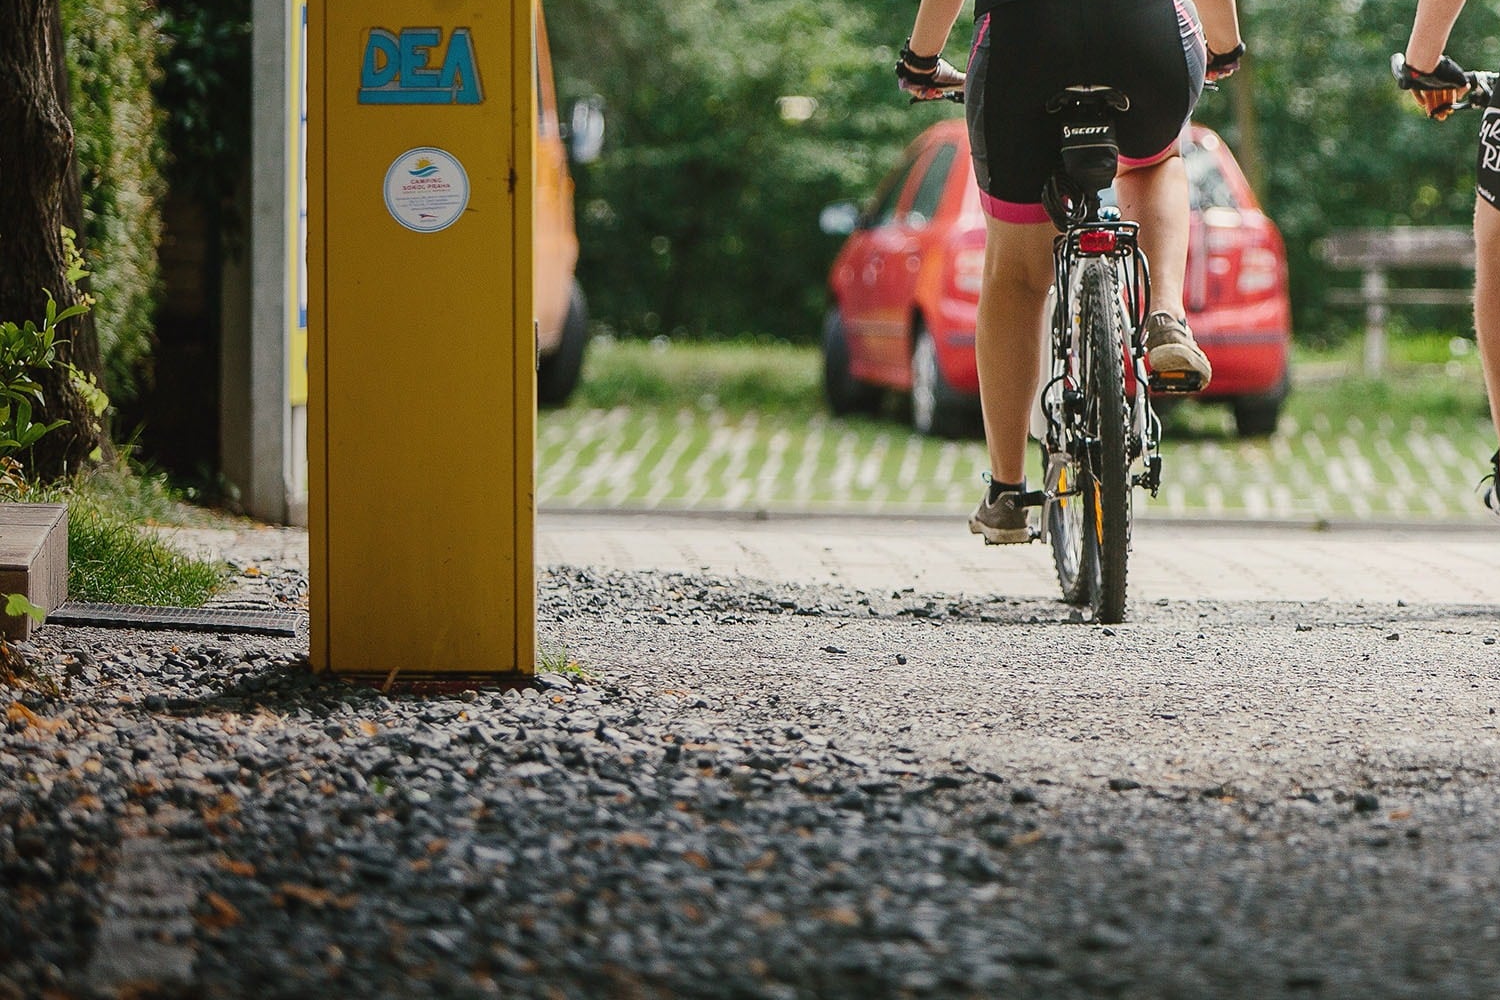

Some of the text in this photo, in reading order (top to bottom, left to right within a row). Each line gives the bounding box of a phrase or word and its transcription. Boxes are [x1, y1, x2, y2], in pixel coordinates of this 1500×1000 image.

[358, 26, 485, 105] DEA
[1071, 126, 1110, 135] SCOTT
[410, 177, 443, 185] CAMPING
